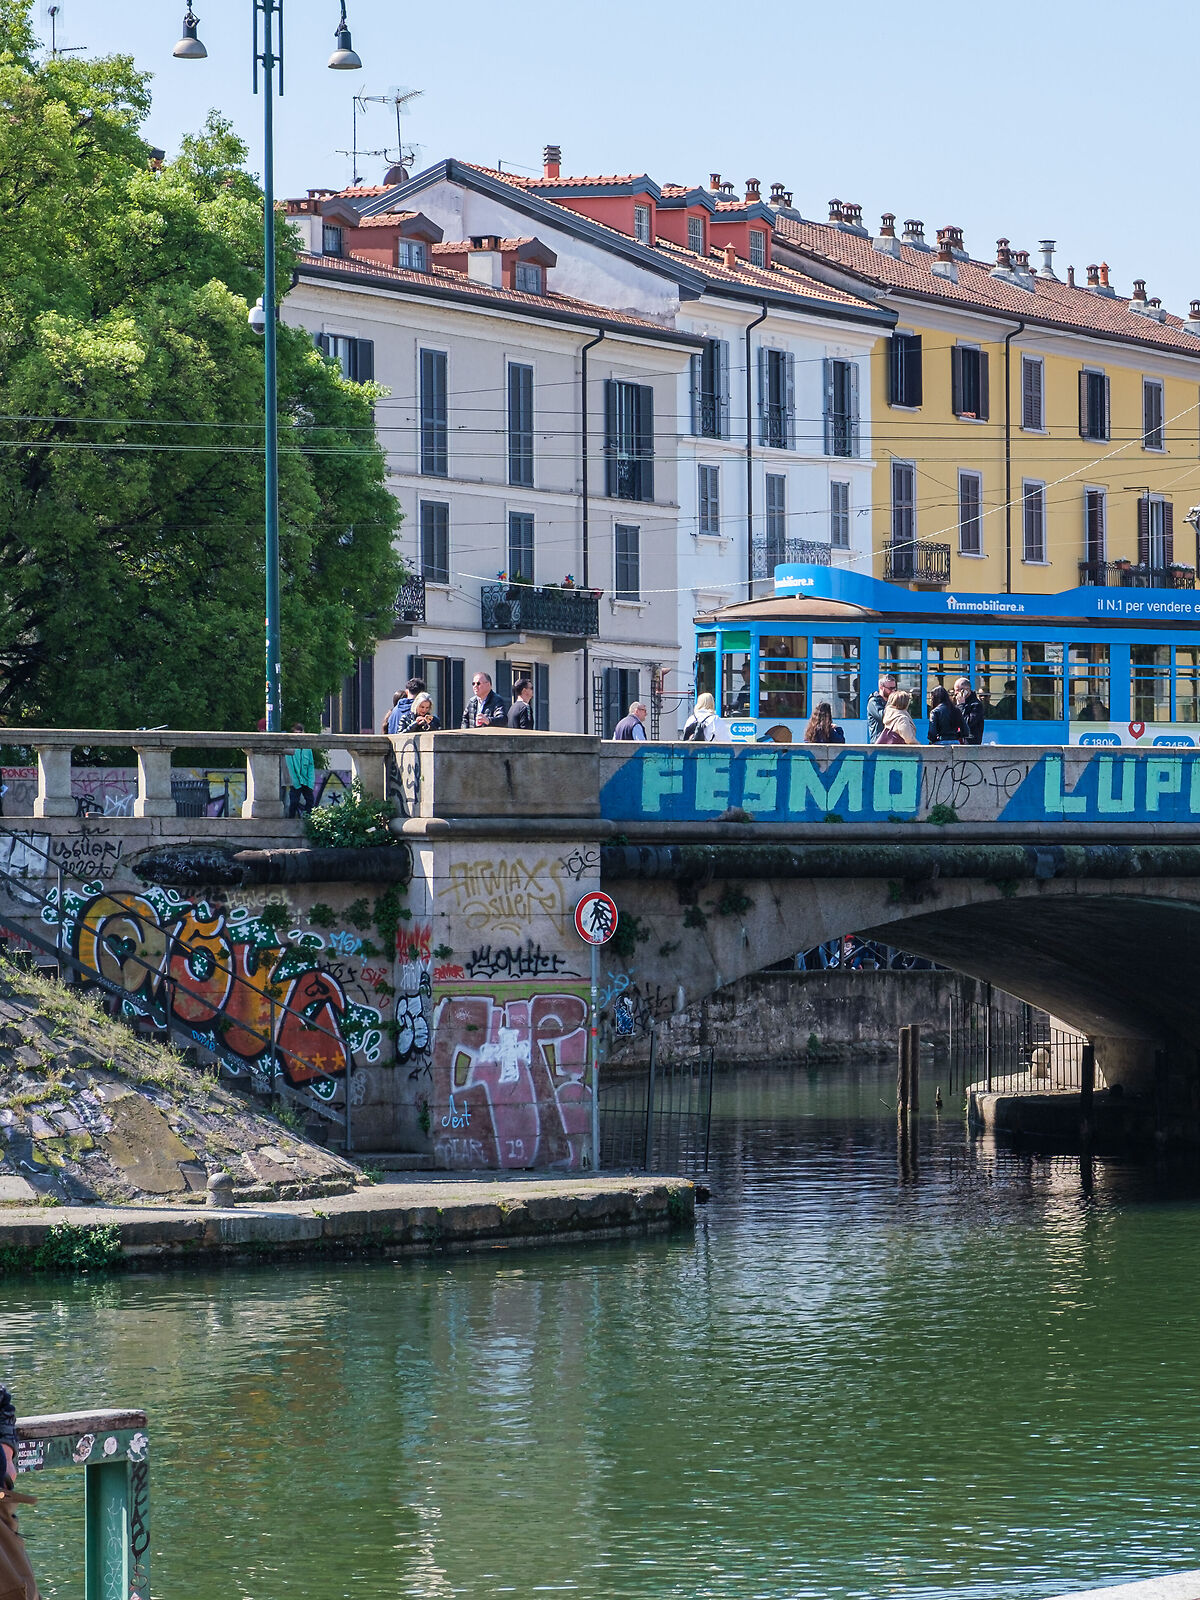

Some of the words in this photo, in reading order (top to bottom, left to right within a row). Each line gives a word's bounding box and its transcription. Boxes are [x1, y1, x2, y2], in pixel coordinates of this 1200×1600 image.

[1097, 599, 1103, 610] il
[1106, 600, 1122, 611] N.1
[1126, 601, 1143, 614] per
[1146, 601, 1191, 613] vendere
[1194, 604, 1200, 613] e
